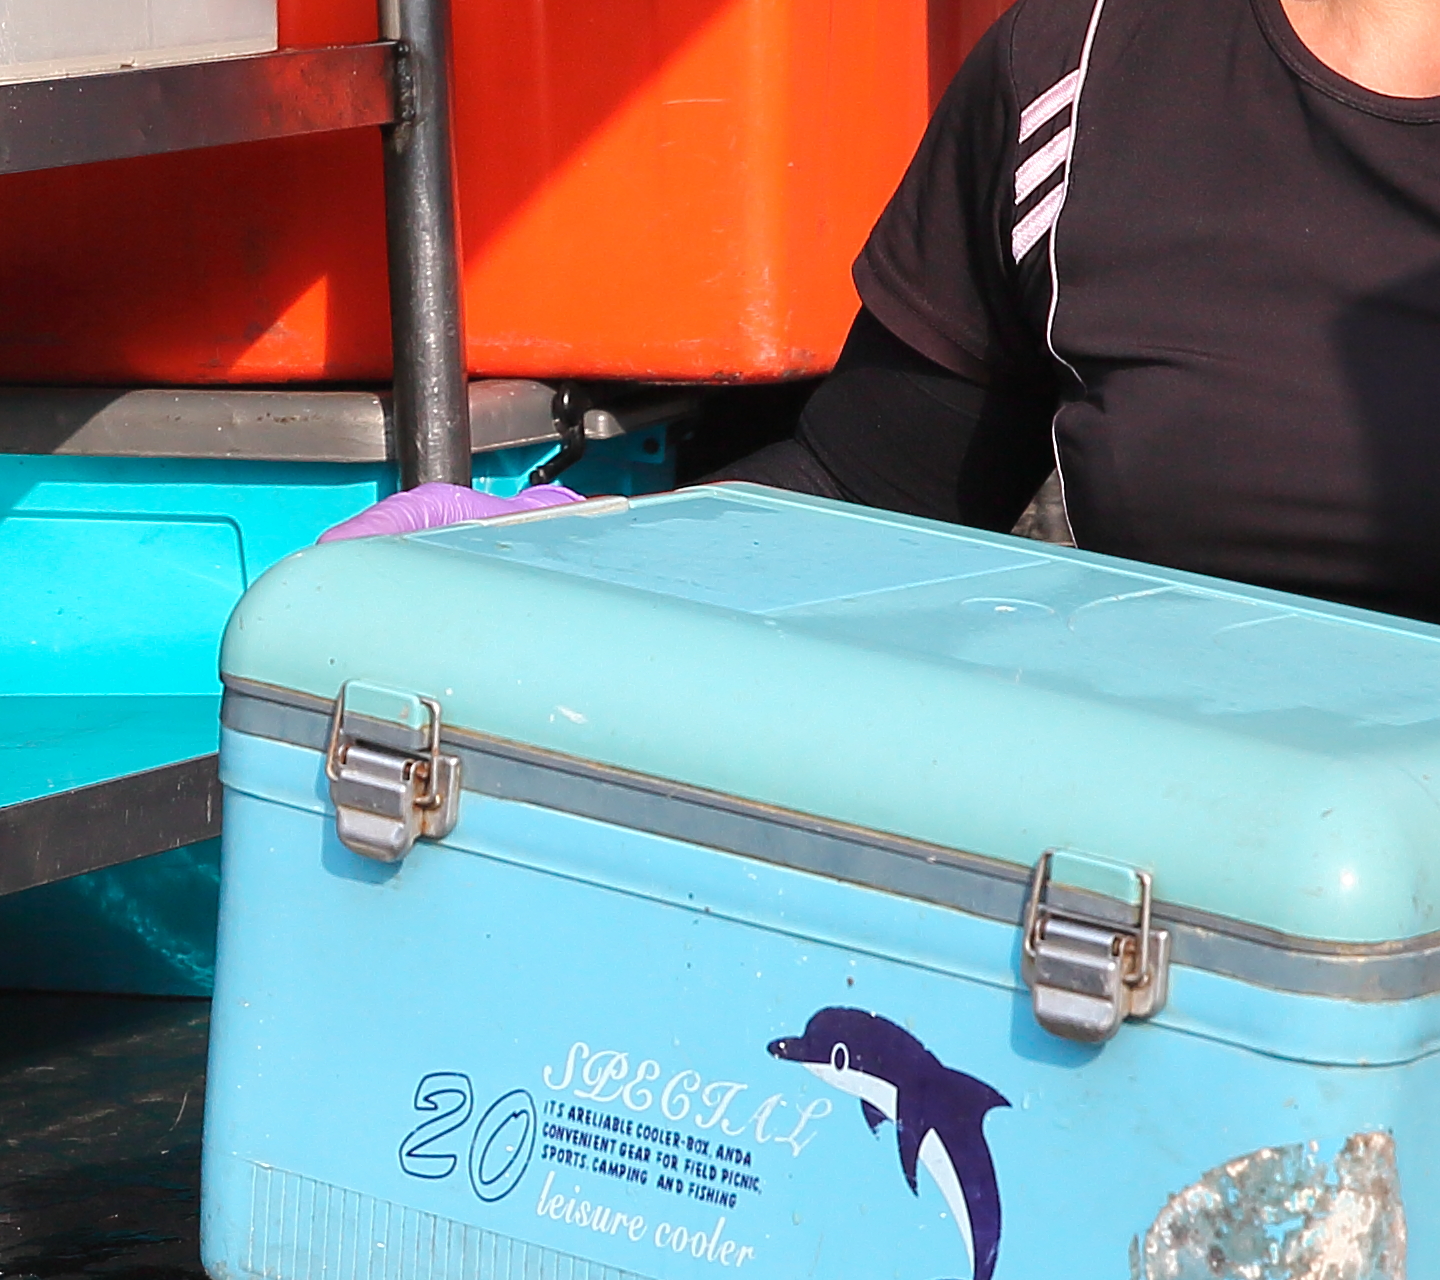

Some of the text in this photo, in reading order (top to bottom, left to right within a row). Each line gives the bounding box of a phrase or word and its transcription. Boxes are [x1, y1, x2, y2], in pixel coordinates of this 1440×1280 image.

[399, 1072, 537, 1203] 20
[542, 1122, 617, 1154] CONVENIENT
[619, 1142, 651, 1162] GEAR
[656, 1151, 678, 1172] FOR
[684, 1158, 717, 1181] FIELD
[536, 1170, 755, 1267] leisure cooler
[592, 1157, 648, 1185] CAMPING
[688, 1182, 737, 1208] FISHING
